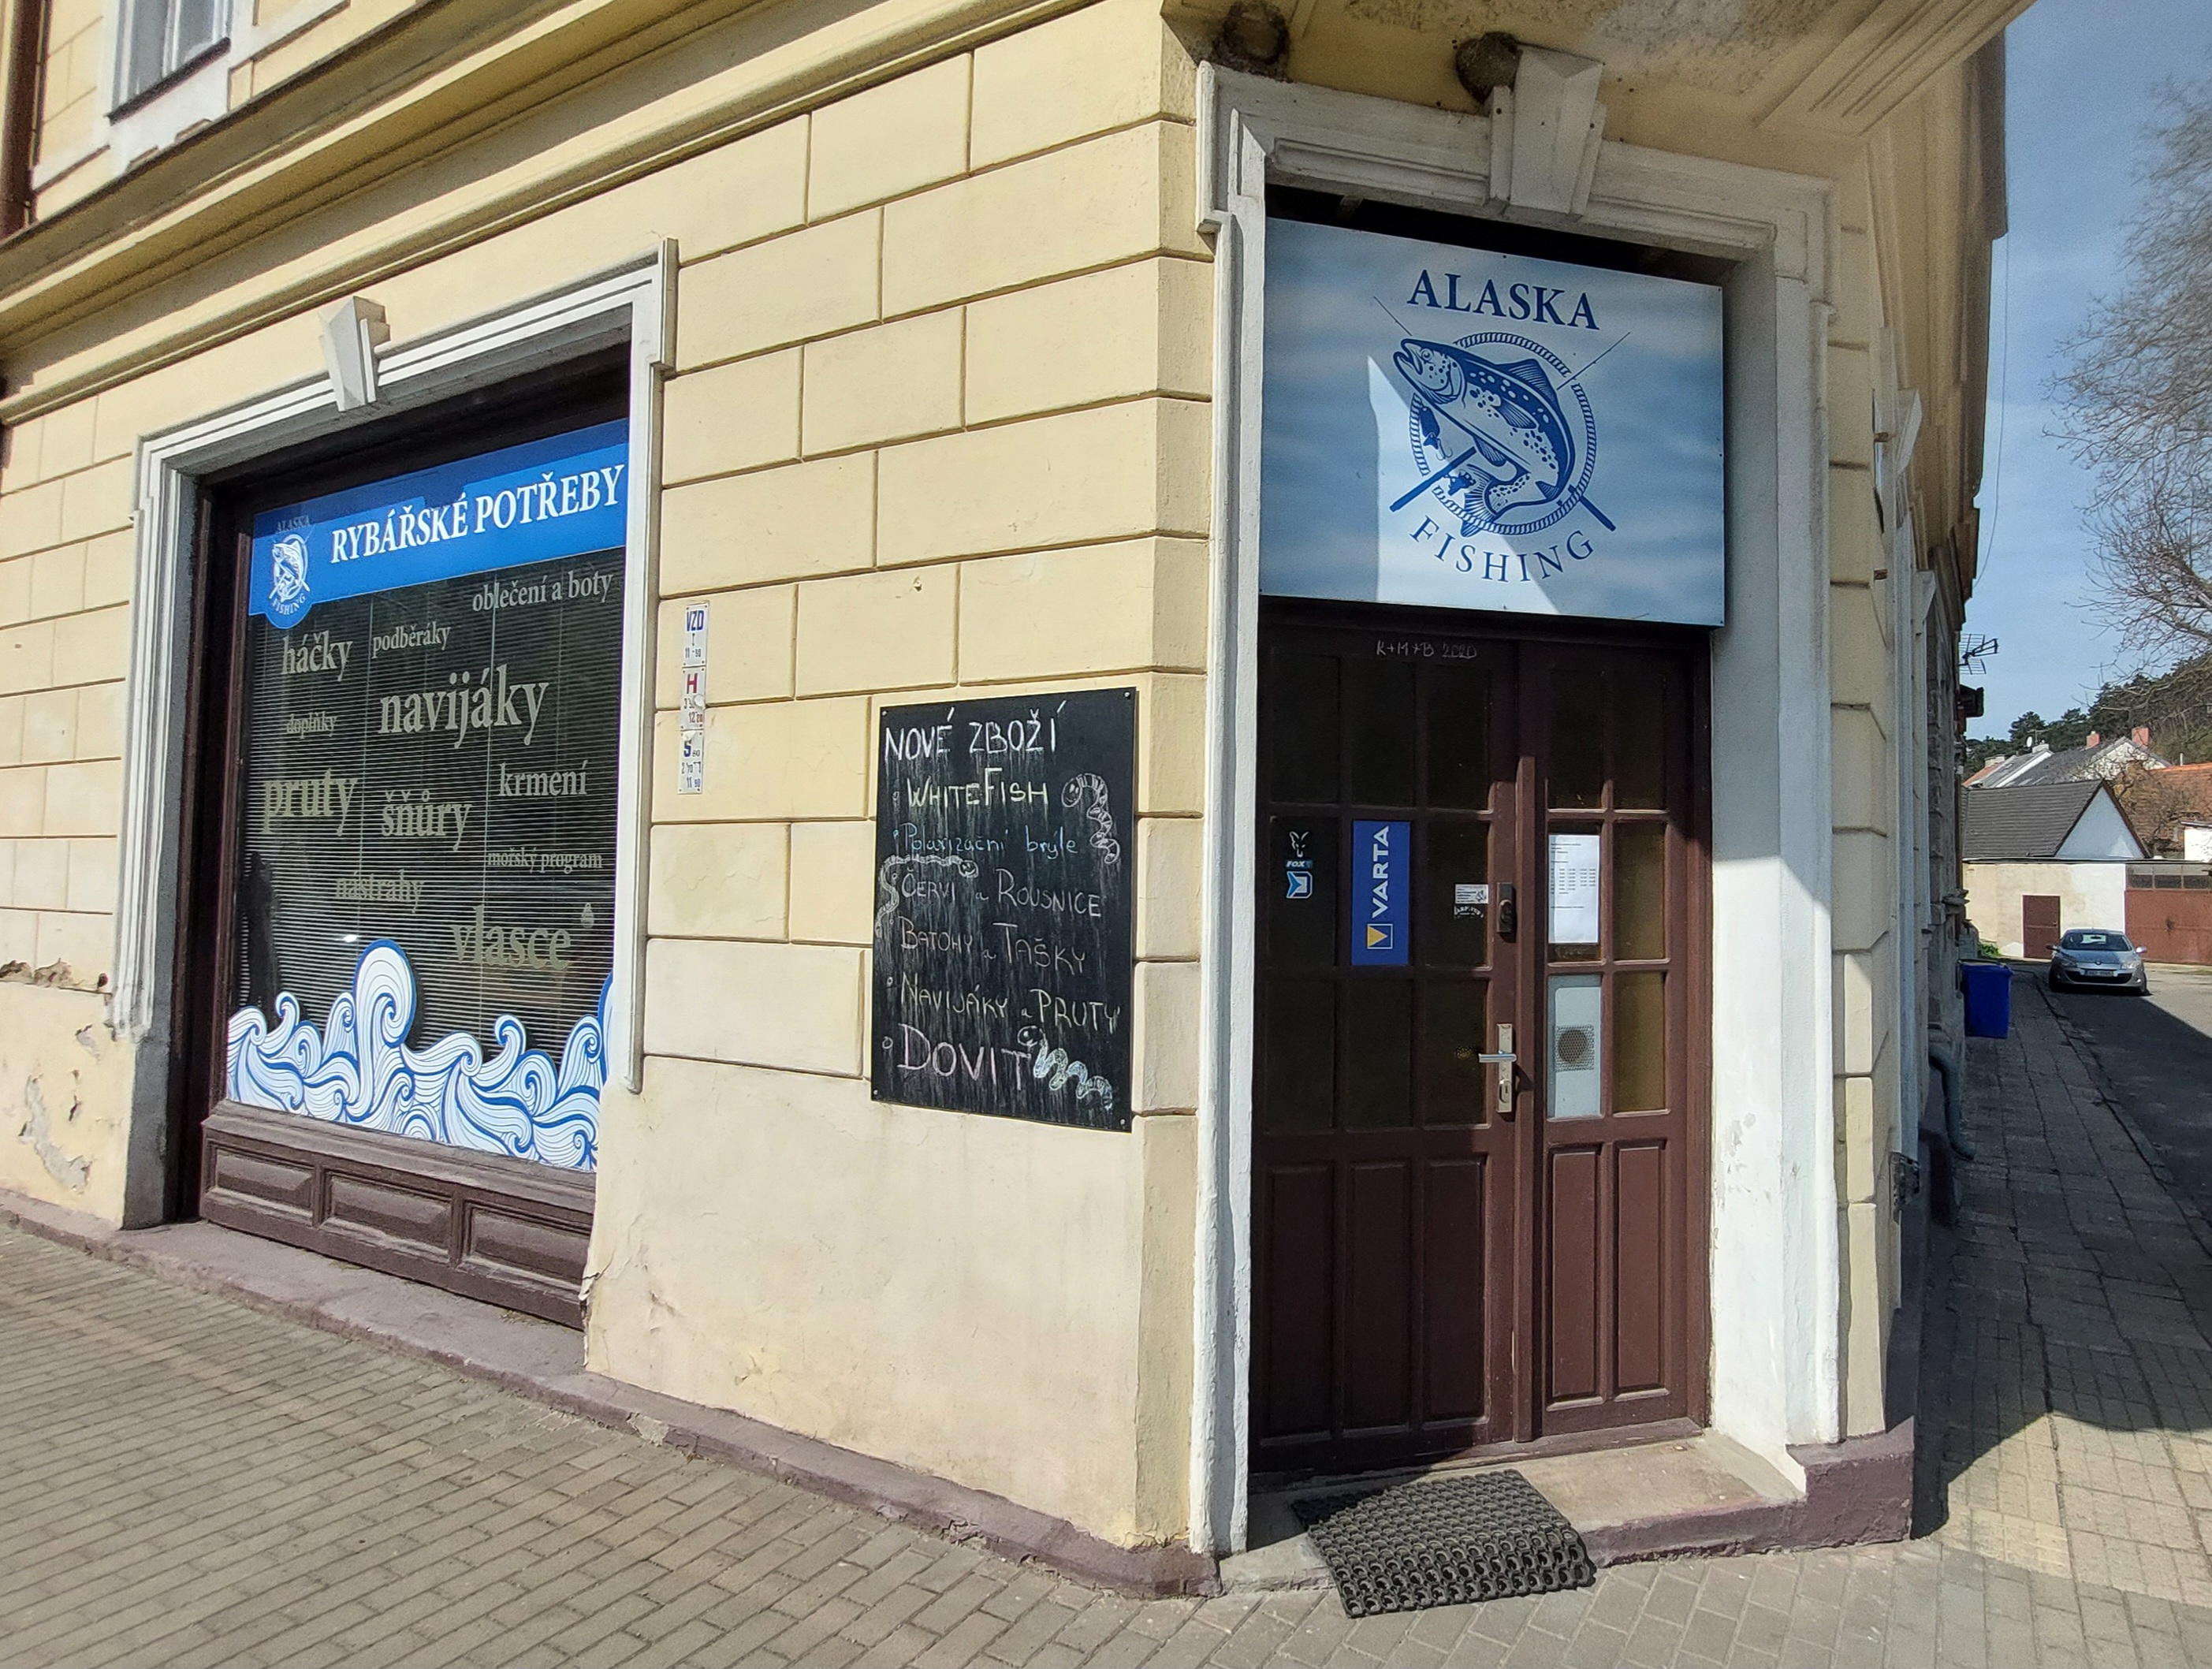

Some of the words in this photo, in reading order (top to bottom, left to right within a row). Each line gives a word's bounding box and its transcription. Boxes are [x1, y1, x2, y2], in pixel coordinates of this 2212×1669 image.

[1406, 269, 1599, 330] ALASKA
[277, 515, 311, 532] ALASKA
[330, 493, 468, 564] RYBÁŘSKÉ
[473, 464, 625, 534] POTŘEBY
[1409, 516, 1594, 583] FISHING
[272, 593, 307, 615] FISHING
[473, 576, 548, 613] oblečení
[552, 583, 563, 601] a
[568, 570, 613, 603] boty
[372, 621, 452, 659] podběráky
[686, 610, 704, 631] VZD
[281, 631, 353, 682] háčky
[687, 672, 698, 695] H
[378, 664, 549, 749] navijáky
[884, 706, 955, 761] NOVÉ
[969, 699, 1067, 754] ZBOŽÍ
[261, 768, 359, 836] pruty
[498, 759, 589, 798] krmení
[382, 789, 474, 851] šňůry
[487, 847, 537, 874] mořský
[538, 853, 603, 874] program
[1372, 825, 1391, 918] VARTA
[335, 870, 425, 914] nástrahy
[449, 904, 572, 970] vlasce
[897, 1023, 1032, 1090] DOVIT
